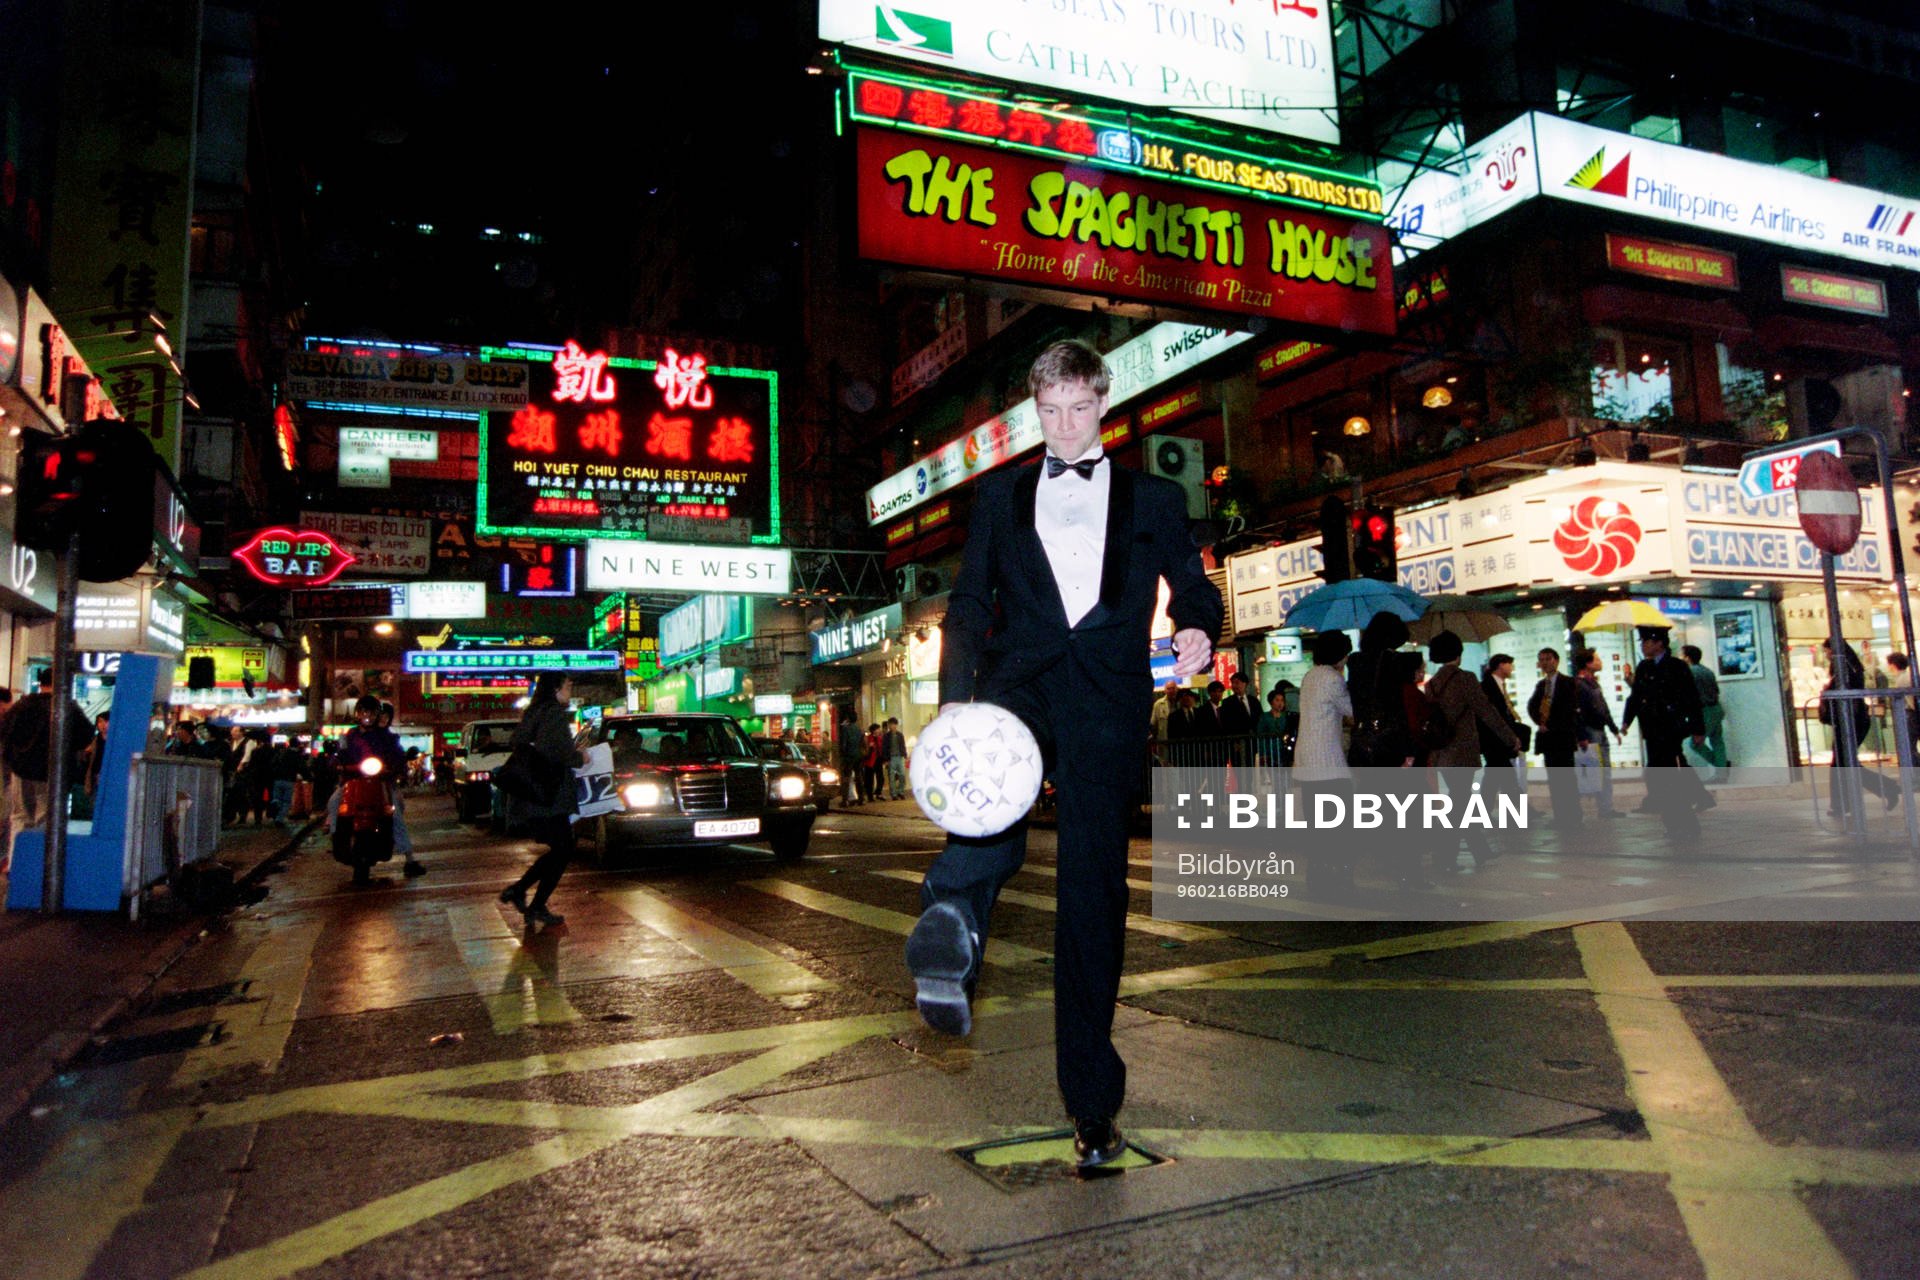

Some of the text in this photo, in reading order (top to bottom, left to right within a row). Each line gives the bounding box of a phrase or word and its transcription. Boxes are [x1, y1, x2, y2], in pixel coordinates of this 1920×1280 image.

[1148, 2, 1246, 54] TOURS
[1264, 30, 1327, 74] LTD.
[986, 29, 1291, 121] CATHAY PACIFIC
[1143, 144, 1180, 171] H.K.
[1185, 153, 1236, 184] FOUR
[1236, 162, 1287, 193] SEAS
[1287, 173, 1353, 206] TOURS
[886, 149, 997, 226] THE
[1268, 218, 1377, 289] HOUSE
[1634, 176, 1826, 240] Philippine Airlines
[1843, 231, 1920, 258] AIR FRAN
[1062, 253, 1086, 281] of
[1092, 258, 1119, 281] the
[1124, 264, 1218, 298] American
[464, 363, 525, 387] GOLF
[1111, 365, 1154, 397] IRLINES
[393, 387, 448, 401] ENTRANCE
[347, 430, 431, 443] CANTEEN
[513, 460, 748, 484] HOI YUET CHIU CHAU RESTAURANT
[879, 489, 913, 516] QANTAS
[169, 492, 185, 551] U2
[304, 516, 337, 532] STAR
[341, 519, 378, 535] GEMS
[1405, 512, 1450, 548] INT
[260, 540, 332, 558] RED LIPS
[1276, 546, 1324, 577] CHE
[1689, 532, 1789, 564] CHANGE
[11, 543, 38, 596] U2
[265, 557, 325, 576] BAR
[602, 555, 777, 580] NINE WEST
[1398, 561, 1454, 591] MBIO
[818, 614, 888, 657] NINE WEST
[82, 652, 121, 673] U2
[935, 744, 993, 812] SELECT
